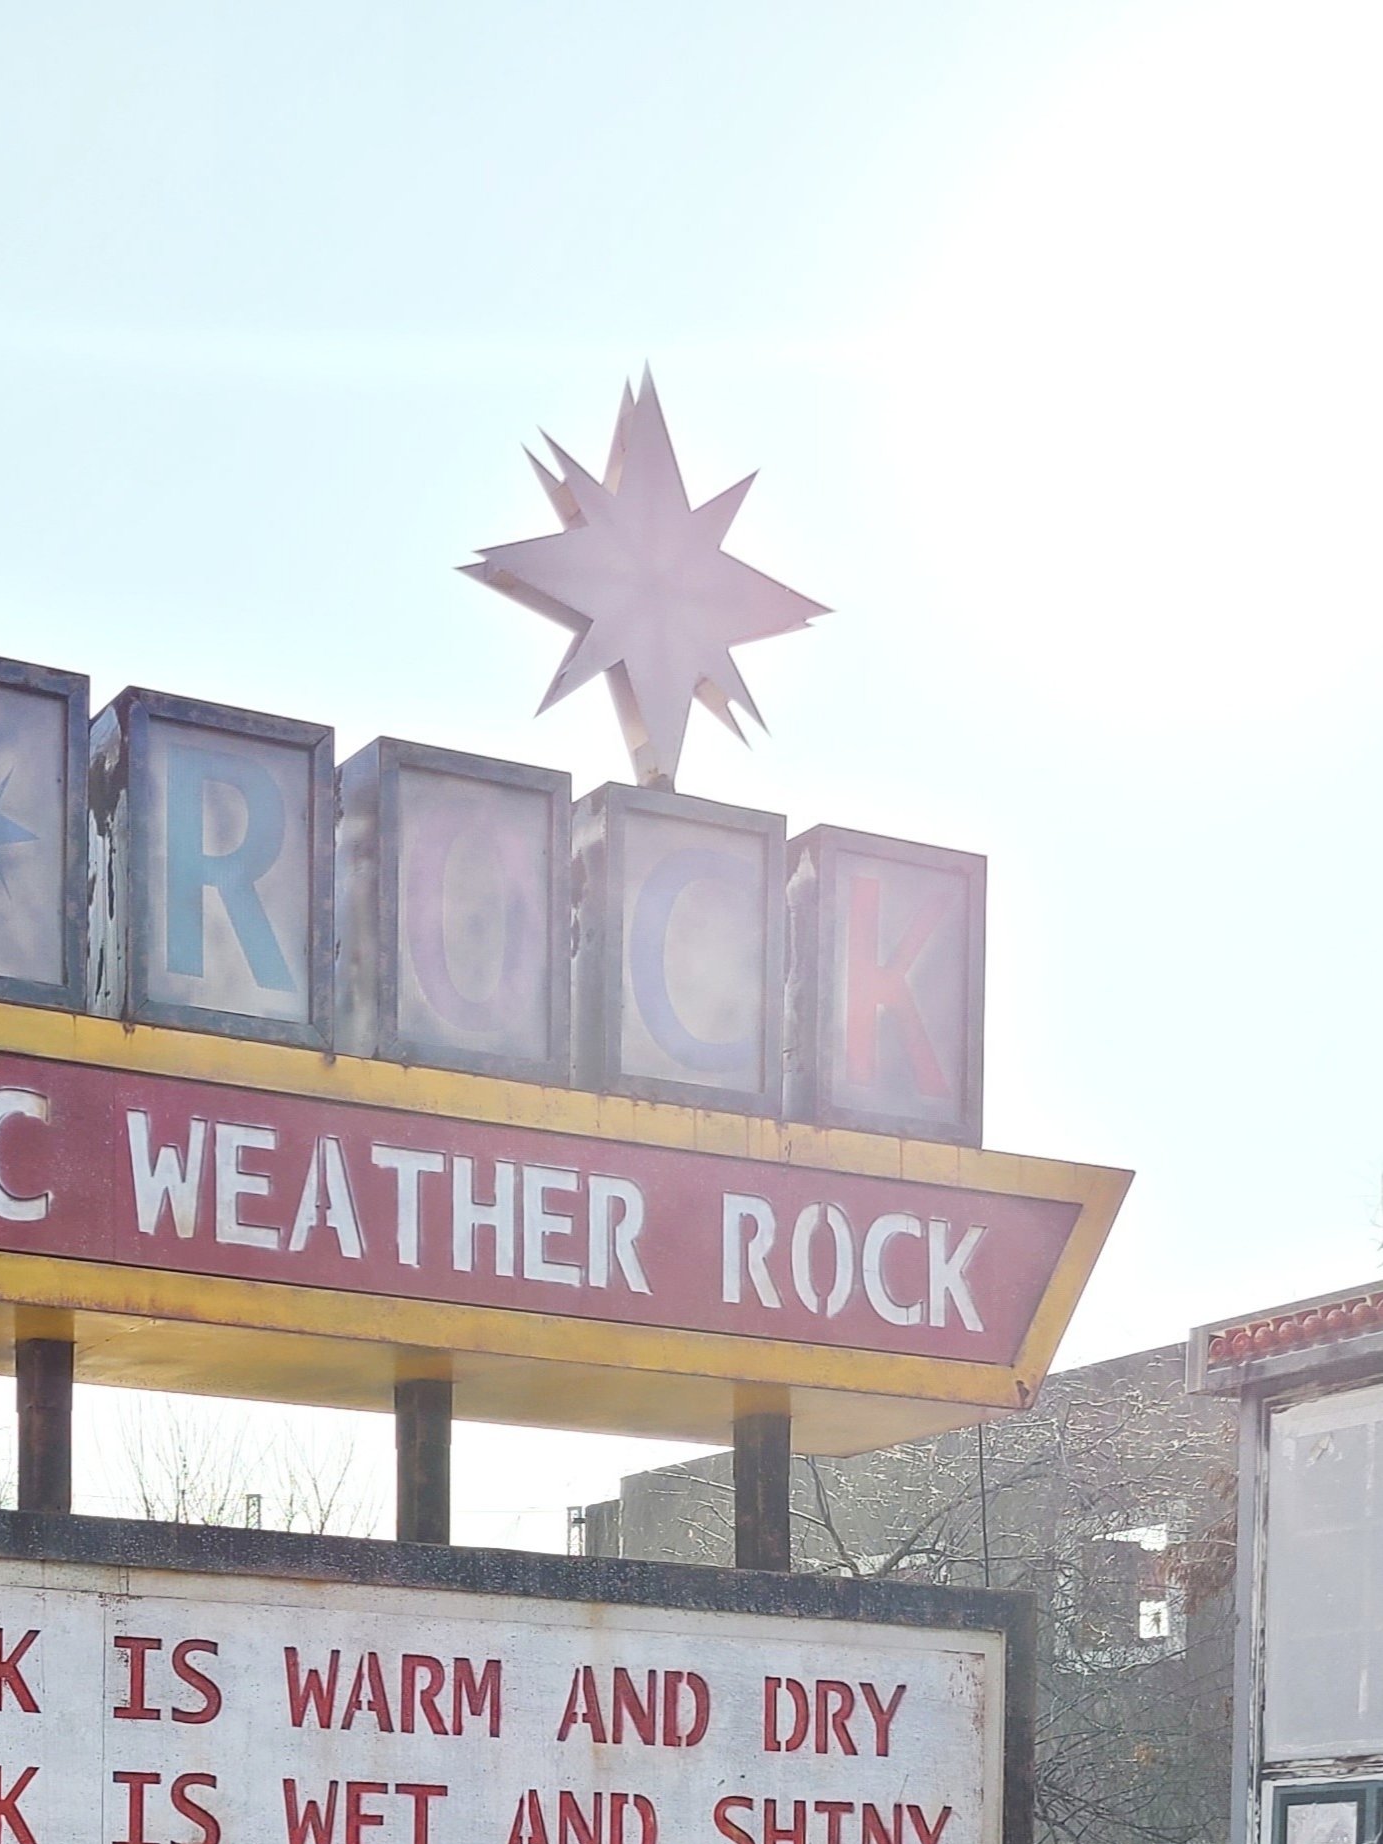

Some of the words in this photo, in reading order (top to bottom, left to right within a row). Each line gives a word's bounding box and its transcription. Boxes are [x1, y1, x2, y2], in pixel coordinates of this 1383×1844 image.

[163, 740, 950, 1100] ROCK
[126, 1107, 654, 1296] WEATHER
[722, 1189, 989, 1333] ROCK
[112, 1635, 223, 1725] IS
[284, 1646, 502, 1738] WARM
[557, 1664, 710, 1749] AND
[763, 1675, 906, 1757] DRY
